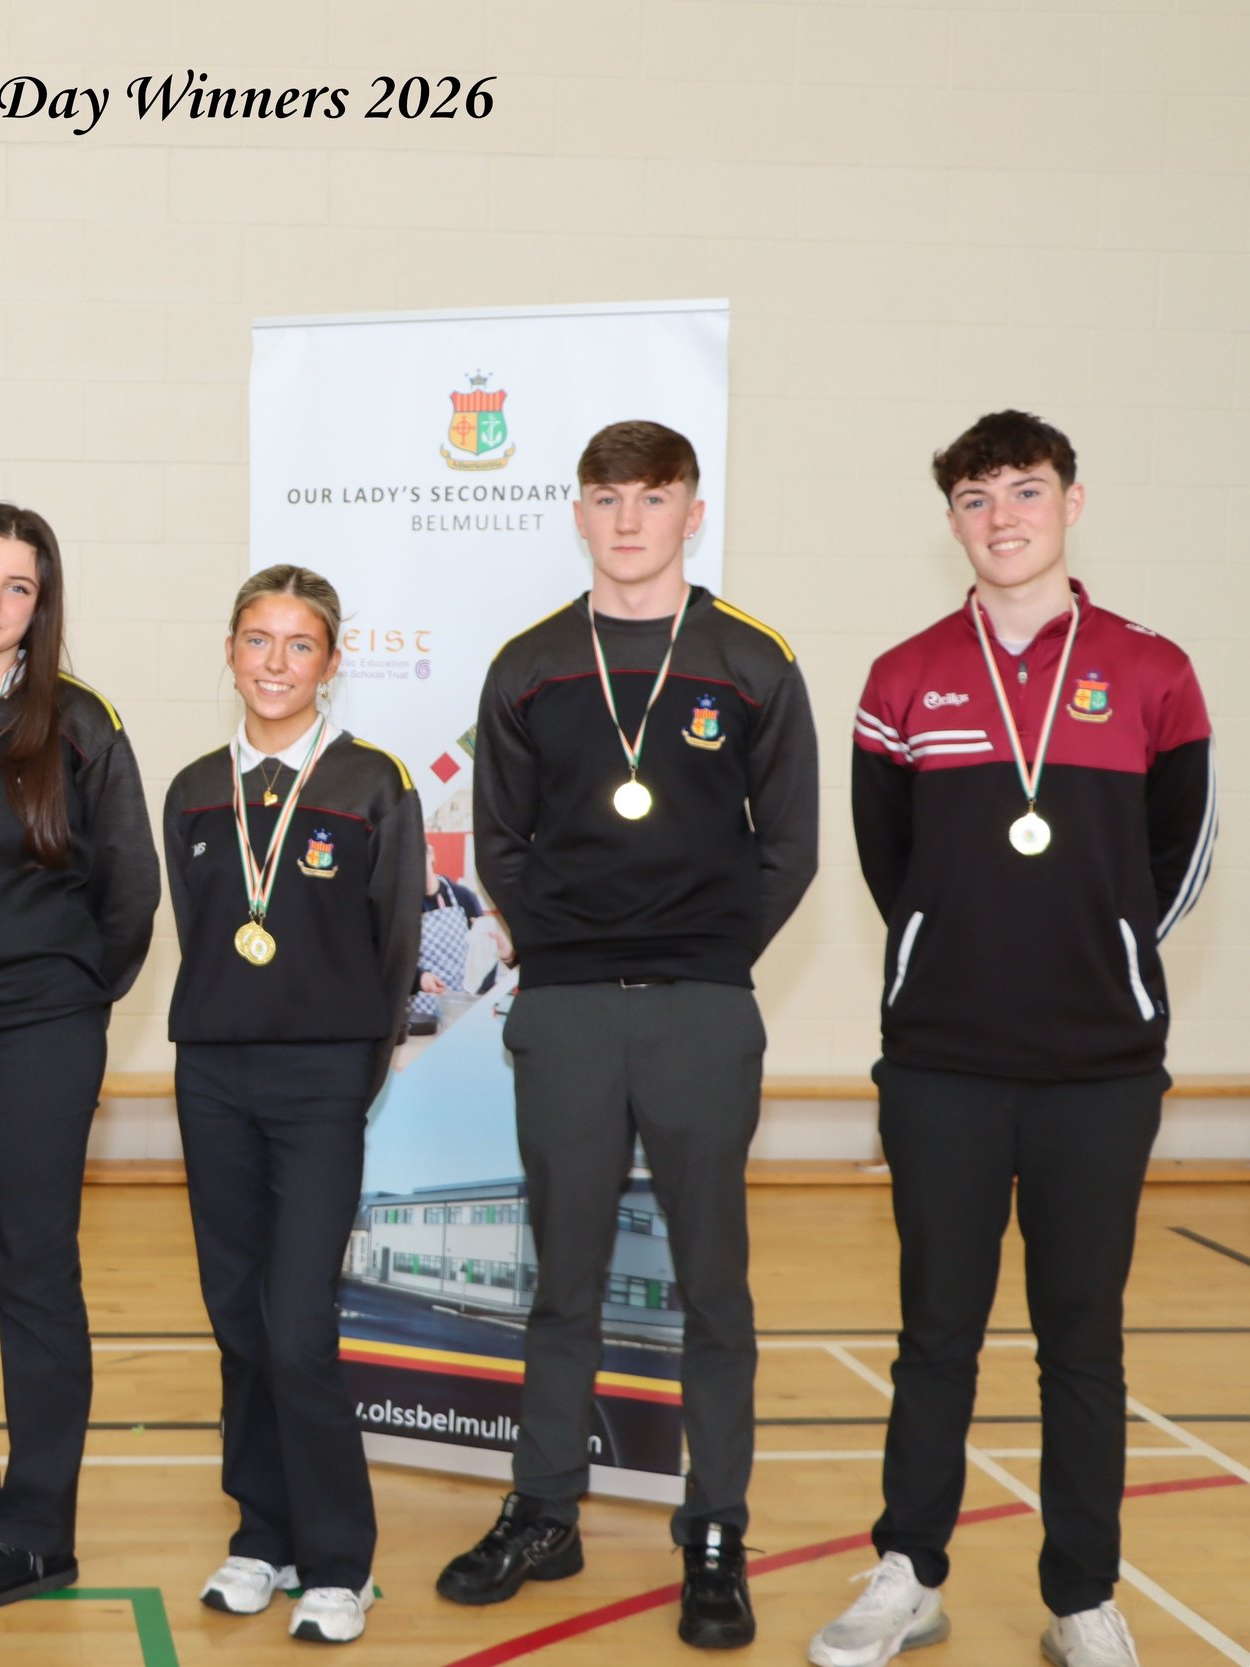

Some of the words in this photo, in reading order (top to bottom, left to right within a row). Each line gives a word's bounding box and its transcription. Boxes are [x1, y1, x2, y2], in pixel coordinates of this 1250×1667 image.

[287, 487, 333, 505] OUR
[342, 485, 421, 504] LADY’S
[430, 483, 573, 503] SECONDARY
[411, 513, 544, 532] BELMULLET
[342, 628, 432, 653] EIST
